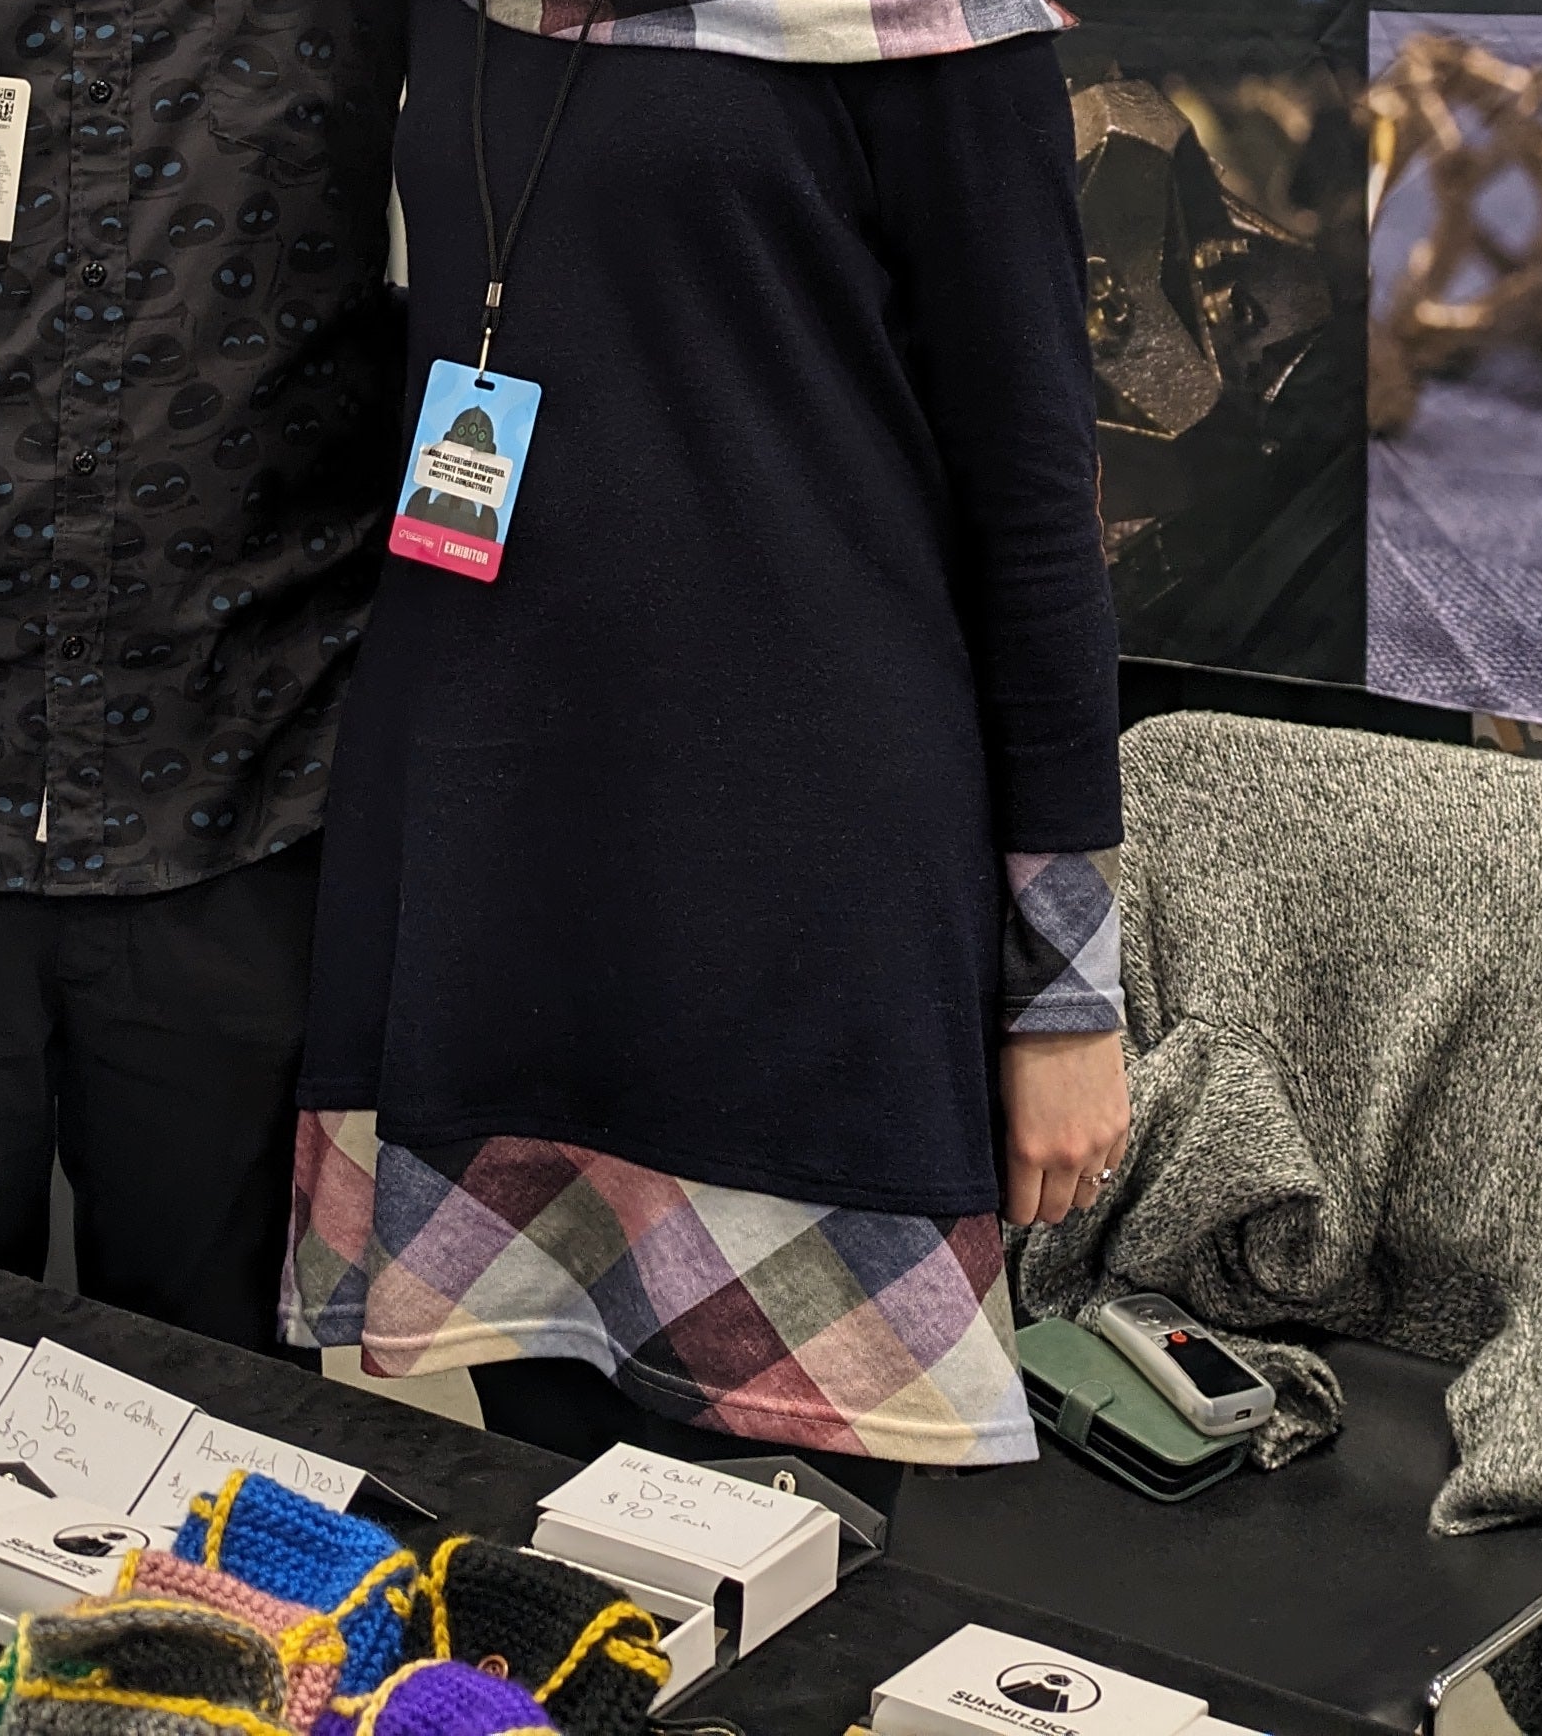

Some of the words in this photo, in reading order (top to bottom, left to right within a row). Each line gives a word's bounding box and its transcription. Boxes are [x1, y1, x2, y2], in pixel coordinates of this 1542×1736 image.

[444, 541, 489, 564] EXHIBITOR
[41, 1395, 77, 1438] D20
[196, 1429, 277, 1475] Assorted
[639, 1480, 697, 1509] D20
[662, 1469, 703, 1488] Gold
[712, 1481, 774, 1509] Plated
[952, 1690, 1030, 1720] SUMMIT
[1030, 1717, 1080, 1736] DICE
